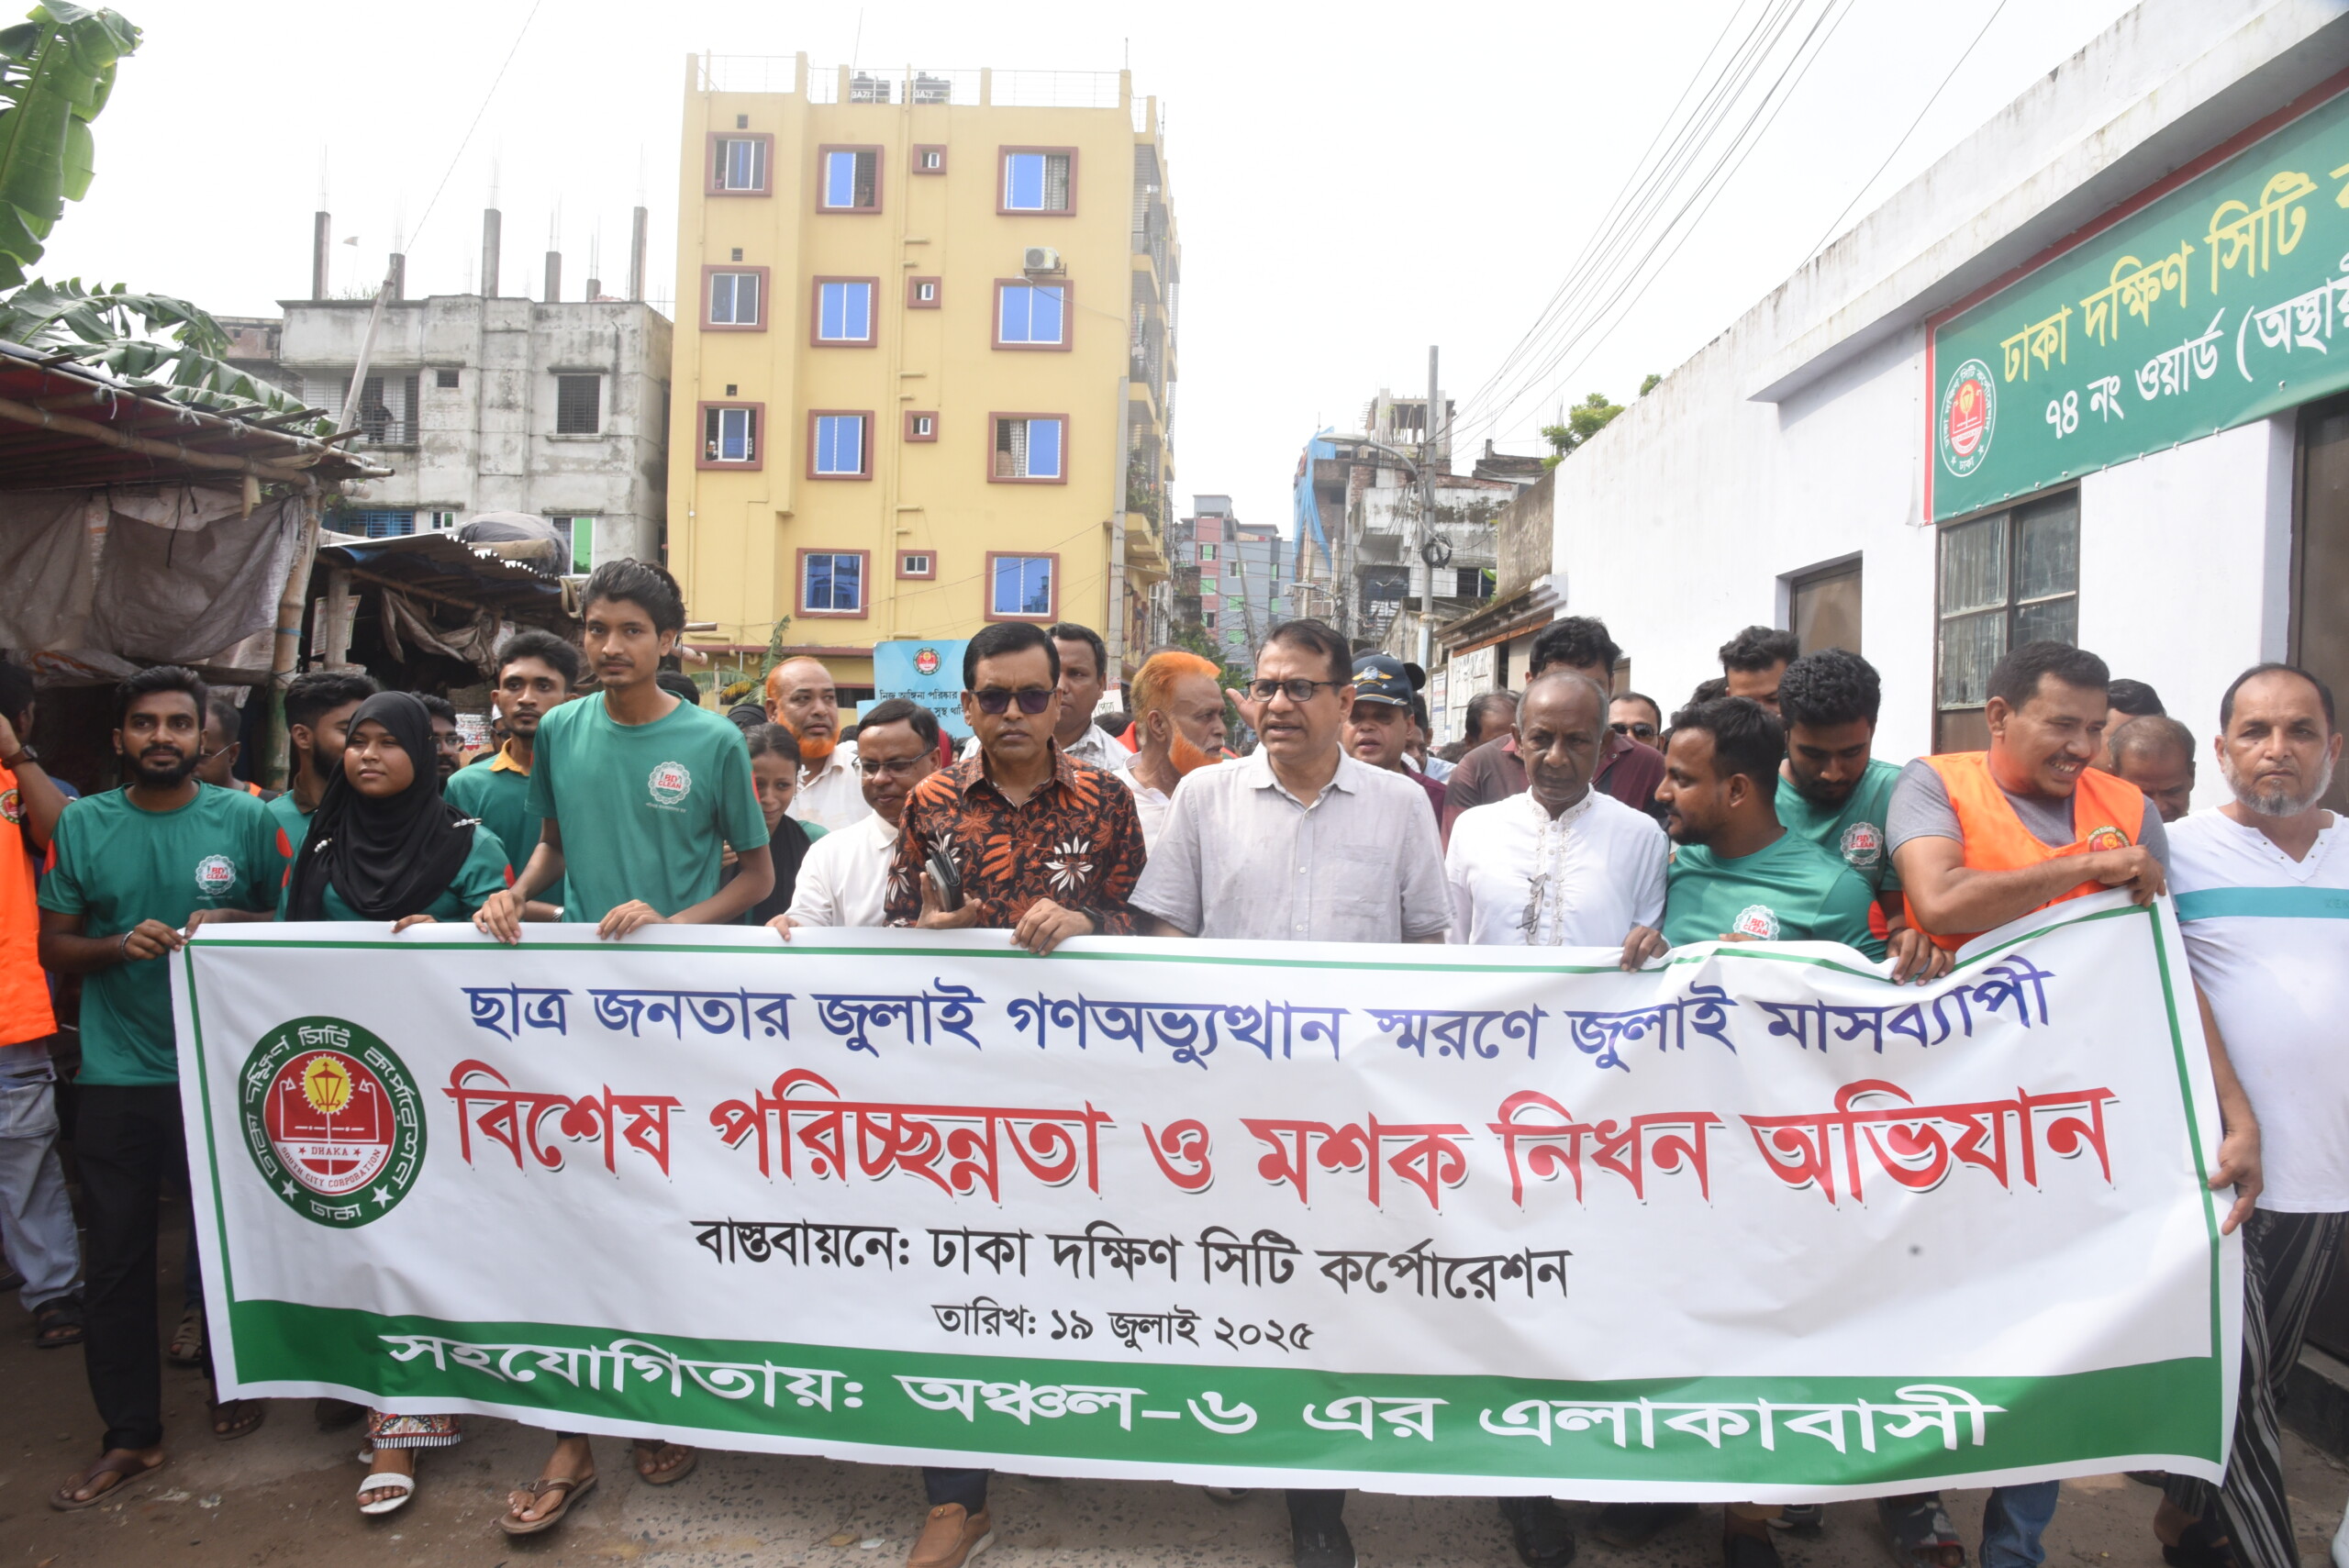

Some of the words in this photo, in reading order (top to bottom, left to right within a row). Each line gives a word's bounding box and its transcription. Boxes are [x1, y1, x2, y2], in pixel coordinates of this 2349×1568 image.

[1999, 304, 2073, 383] ঢাকা
[2079, 255, 2196, 347] দক্ষিণ
[2203, 171, 2319, 295] সিটি
[2045, 390, 2078, 439] ৭৪
[2087, 375, 2124, 423] নং
[2134, 306, 2226, 401] ওয়ার্ড
[658, 780, 682, 790] CLEAN
[664, 773, 678, 783] BD
[1743, 924, 1769, 936] CLEAN
[1751, 917, 1765, 928] BD
[460, 983, 573, 1042] ছাত্র
[586, 986, 796, 1041] জনতার
[810, 976, 985, 1058] জুলাই
[1008, 991, 1351, 1070] গণঅভ্যুত্থান
[1363, 1004, 1550, 1061] স্মরণে
[1564, 981, 1738, 1073] জুলাই
[1753, 955, 2056, 1054] মাসব্যাপী
[298, 1025, 351, 1049] সিটি
[311, 1147, 349, 1156] DHAKA
[441, 1059, 685, 1184] বিশেষ
[709, 1068, 1117, 1208] পরিচ্ছন্নতা
[1142, 1118, 1215, 1194] ও
[1239, 1111, 1474, 1215] মশক
[1486, 1090, 1726, 1210] নিধন
[1739, 1079, 2121, 1210] অভিযান
[281, 1147, 303, 1177] SOUTH
[305, 1173, 324, 1187] CITY
[328, 1149, 382, 1188] CORPORATION
[309, 1199, 362, 1220] ঢাকা
[925, 1226, 1035, 1277] ঢাকা
[1045, 1219, 1185, 1283] দক্ষিণ
[1195, 1225, 1303, 1288] সিটি
[1314, 1238, 1574, 1301] কর্পোরেশন
[1051, 1308, 1094, 1340] ১৯
[1107, 1304, 1201, 1352] জুলাই
[1214, 1317, 1315, 1352] ২০২৫
[1303, 1395, 1451, 1441] এর
[1479, 1383, 2009, 1454] এলাকাবাসী
